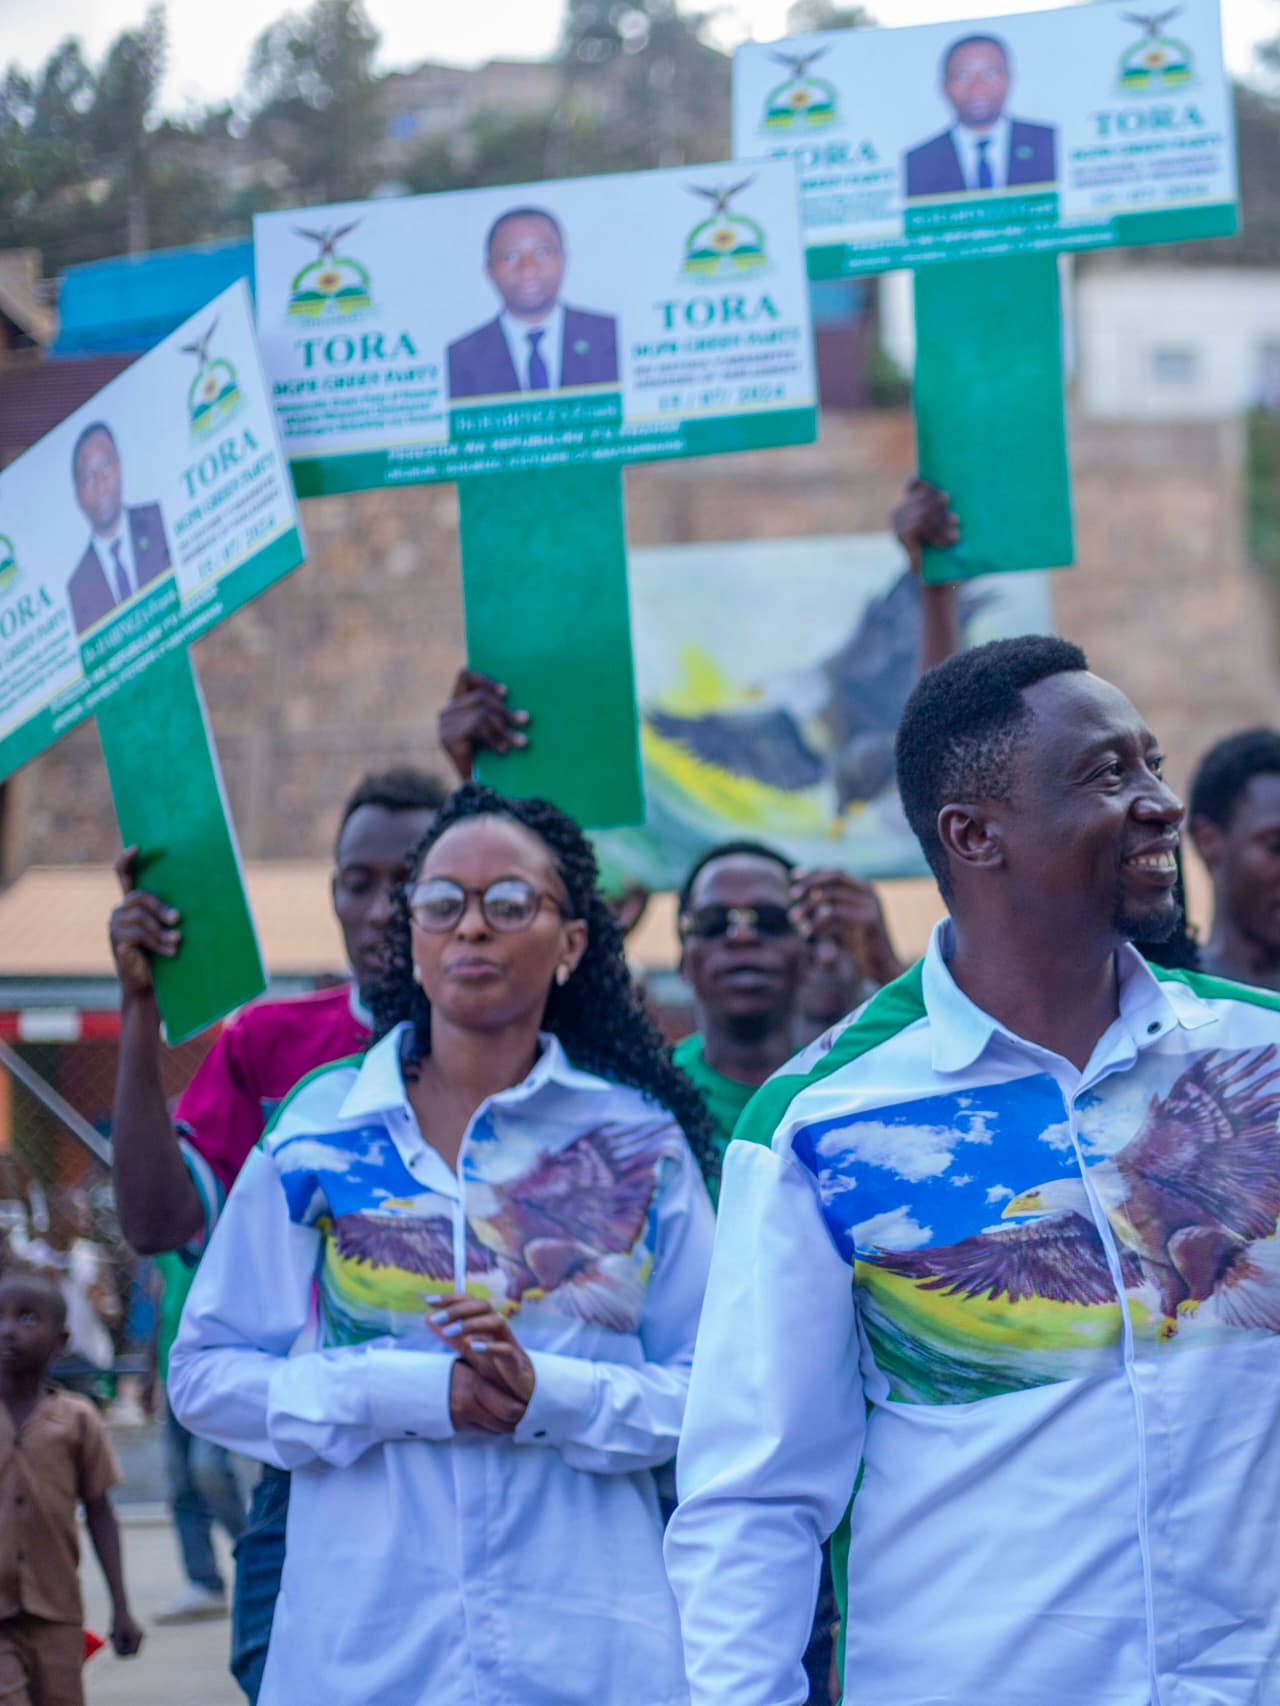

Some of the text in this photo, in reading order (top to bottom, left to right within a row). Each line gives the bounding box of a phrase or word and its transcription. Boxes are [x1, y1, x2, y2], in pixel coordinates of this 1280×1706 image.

[1089, 104, 1205, 136] TORA
[655, 293, 780, 331] TORA
[296, 332, 417, 368] TORA
[179, 428, 258, 497] TORA
